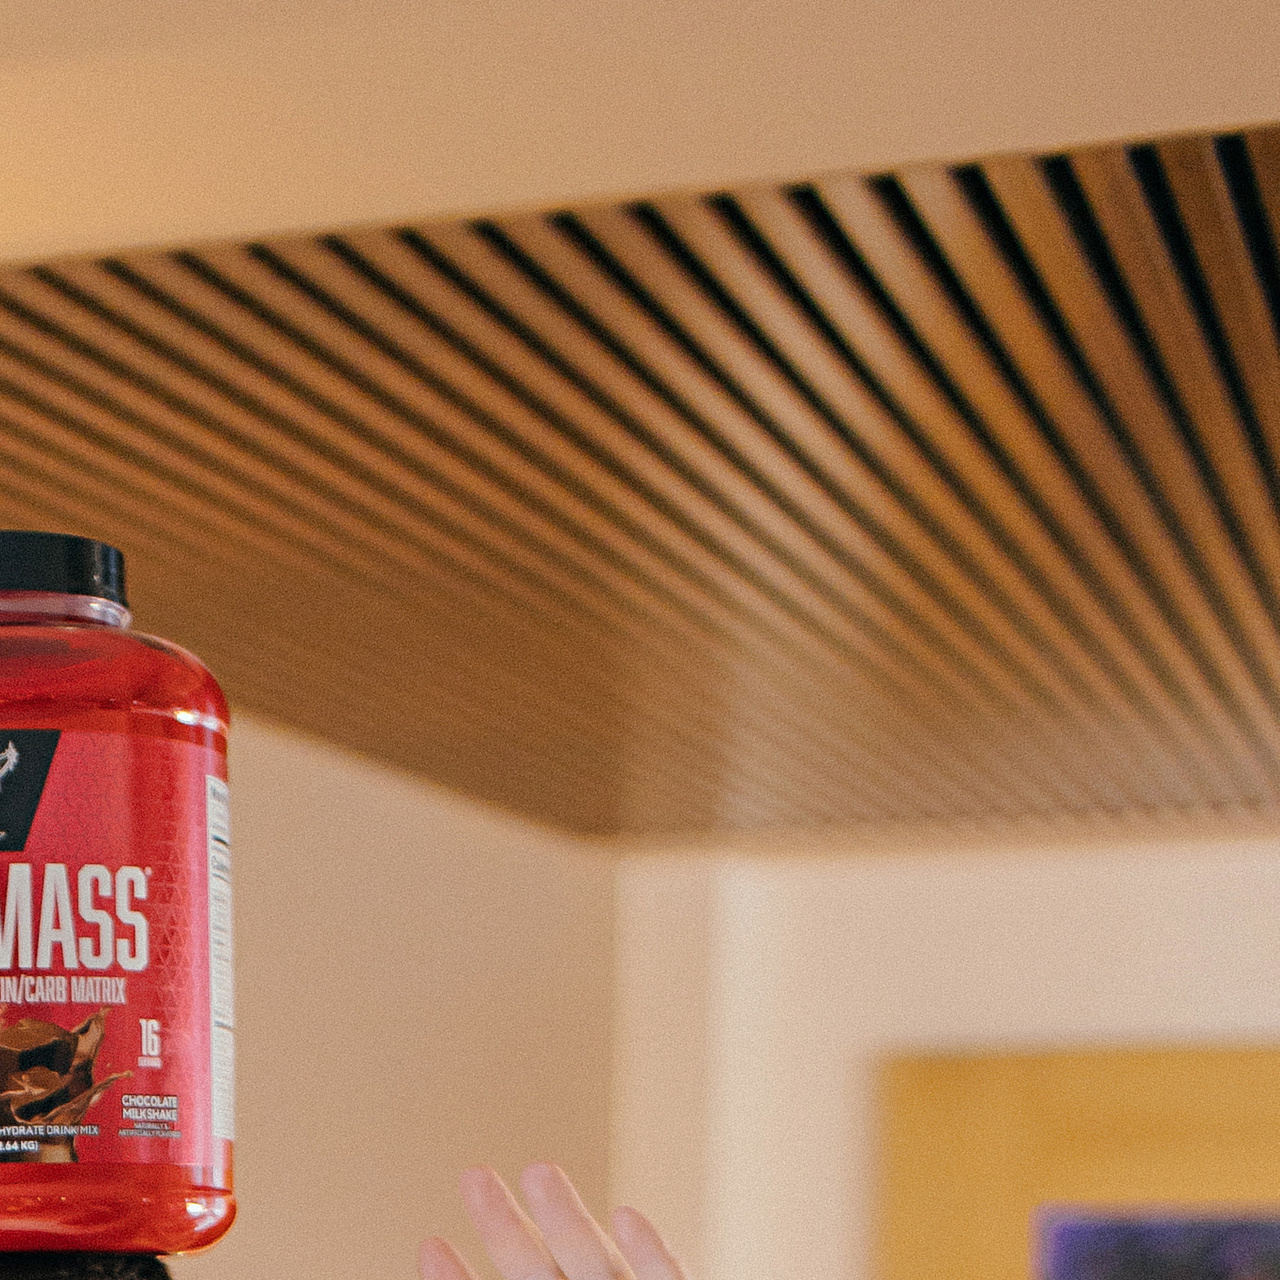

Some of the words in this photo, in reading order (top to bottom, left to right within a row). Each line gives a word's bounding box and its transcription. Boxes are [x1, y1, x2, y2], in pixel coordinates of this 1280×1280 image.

[71, 976, 126, 1004] MATRIX
[139, 1019, 161, 1056] 16
[121, 1095, 178, 1108] CHOCOLATE
[46, 1124, 78, 1136] DRINK
[80, 1124, 99, 1135] MIX
[20, 1140, 39, 1151] KG)
